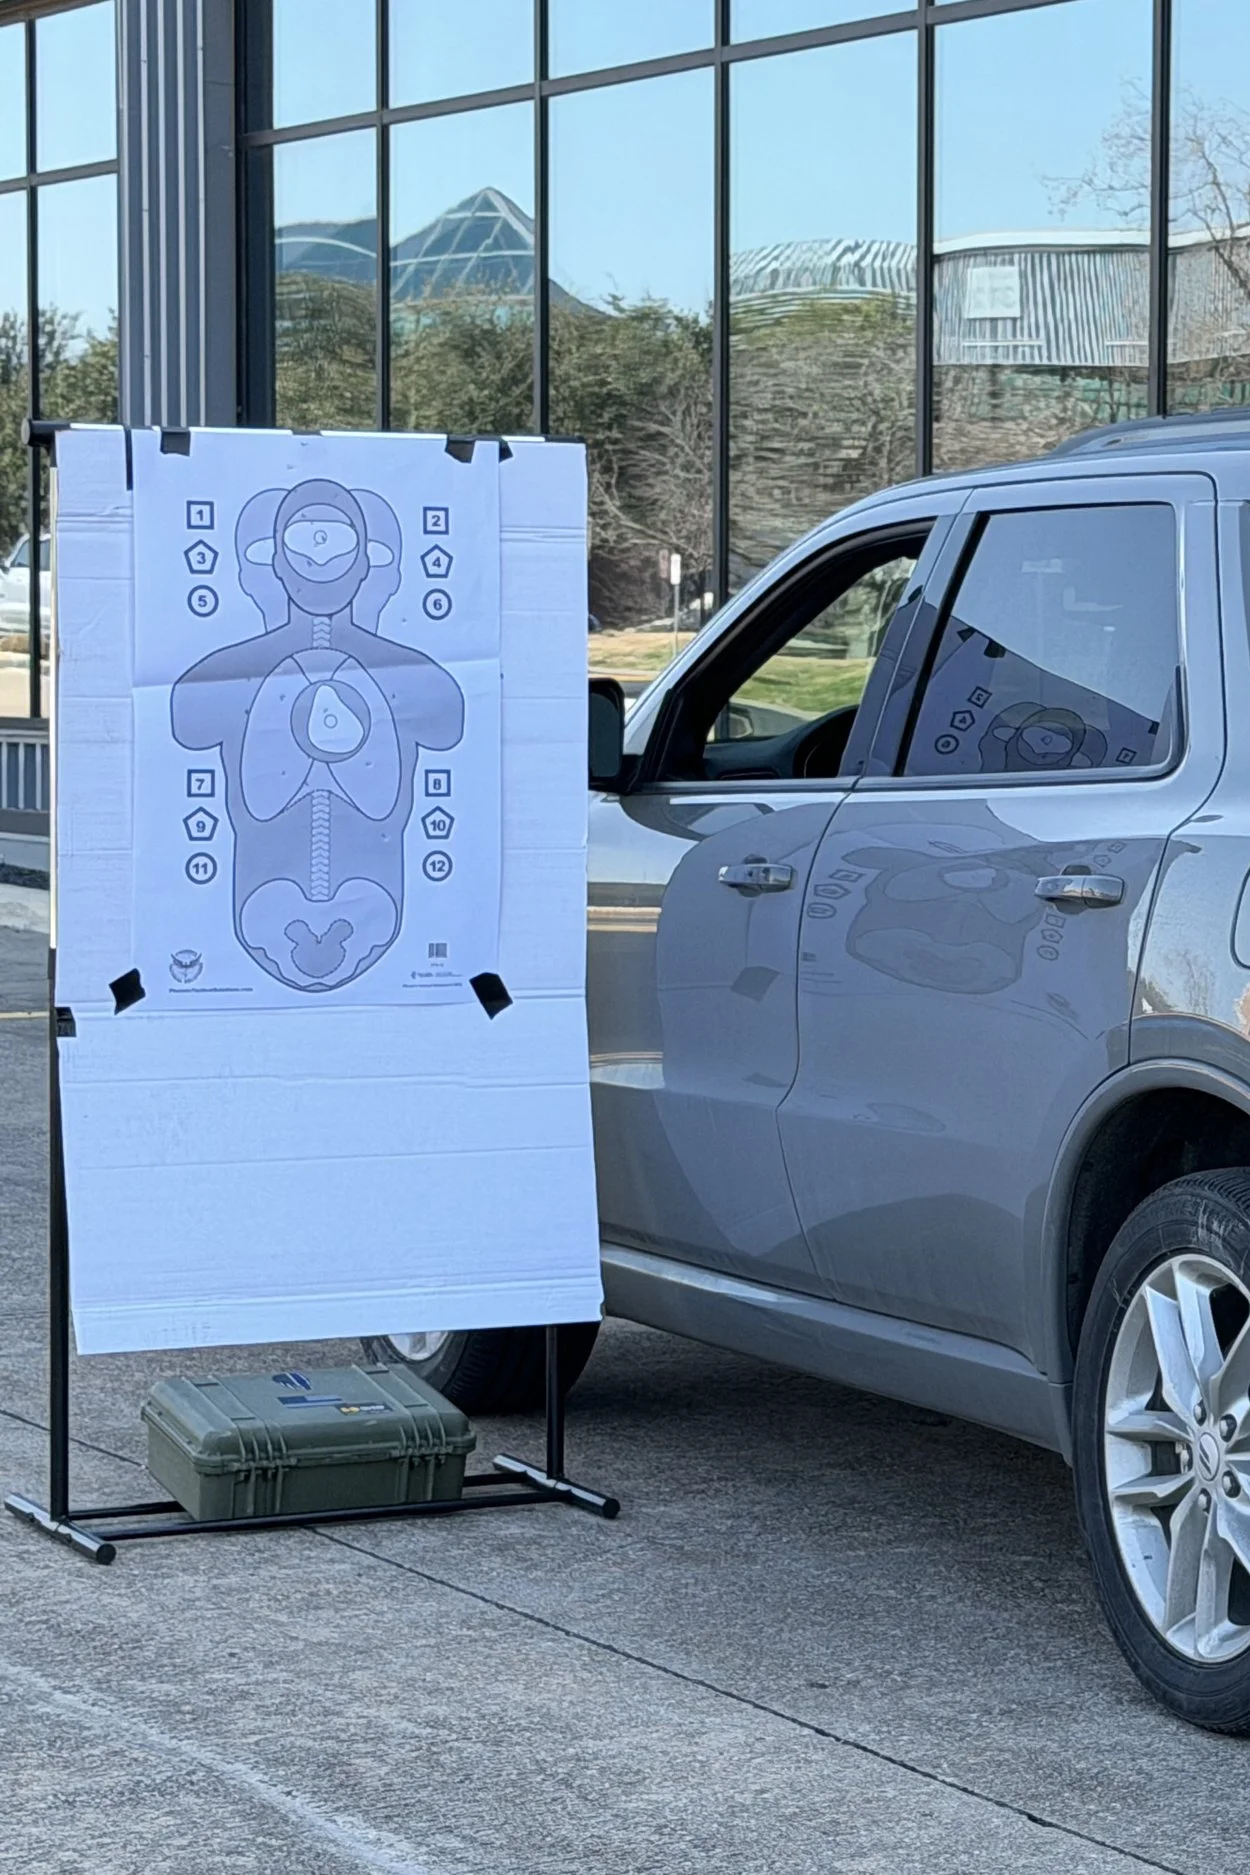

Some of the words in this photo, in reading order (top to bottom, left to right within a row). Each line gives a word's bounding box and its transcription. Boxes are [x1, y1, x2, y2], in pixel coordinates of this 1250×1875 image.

[196, 509, 204, 522] 1
[431, 514, 441, 527] 2
[196, 551, 207, 565] 3
[432, 556, 442, 569] 4
[197, 594, 208, 608] 5
[432, 598, 443, 612] 6
[195, 778, 205, 791] 7
[432, 778, 442, 791] 8
[195, 820, 207, 833] 9
[429, 819, 447, 832] 10
[192, 862, 208, 875] 11
[429, 859, 446, 873] 12
